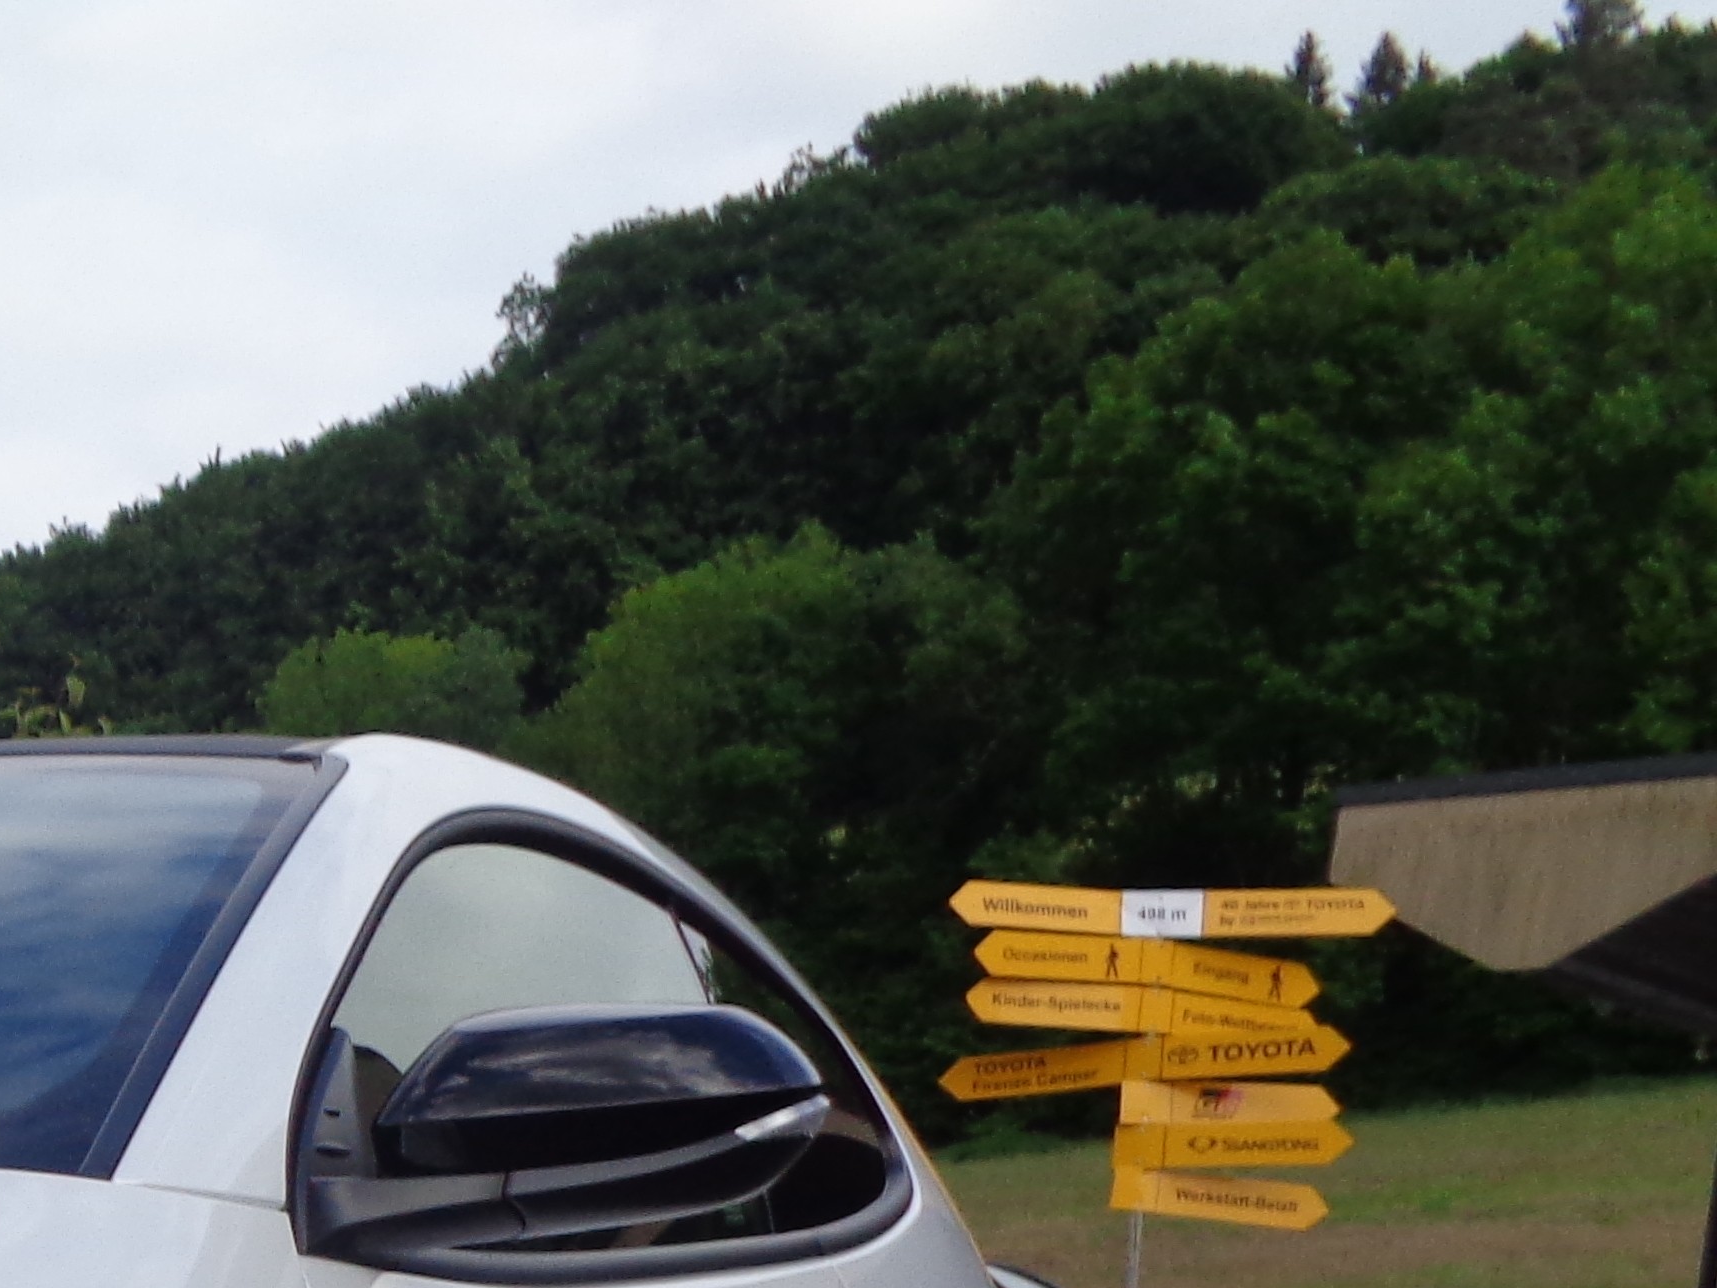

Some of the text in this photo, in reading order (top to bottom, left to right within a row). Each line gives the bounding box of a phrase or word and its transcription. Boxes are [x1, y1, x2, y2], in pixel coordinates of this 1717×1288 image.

[983, 896, 1088, 920] Willkommen
[1209, 1037, 1316, 1062] TOYOTA
[974, 1056, 1047, 1075] TOYOTA
